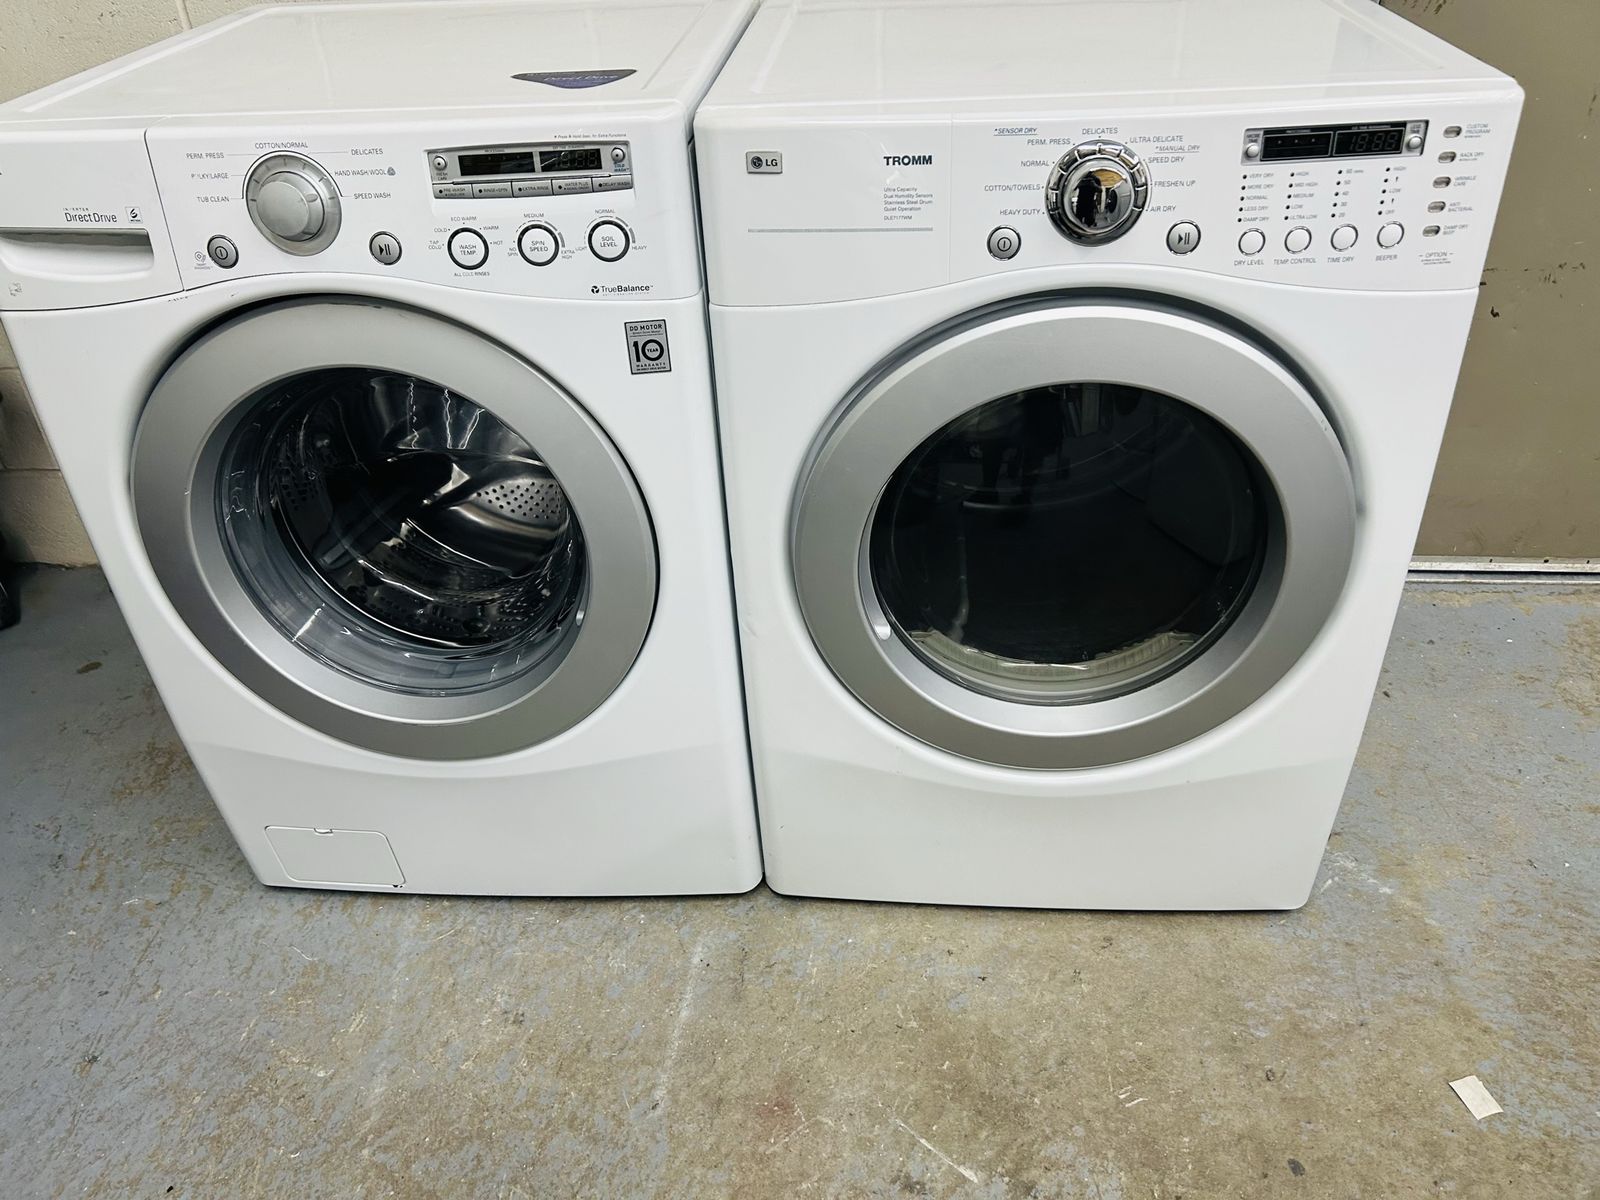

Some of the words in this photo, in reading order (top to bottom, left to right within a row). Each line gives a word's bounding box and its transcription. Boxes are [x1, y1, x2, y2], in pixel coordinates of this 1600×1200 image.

[1081, 127, 1118, 135] DELICATES
[1129, 136, 1151, 144] ULTRA
[1152, 135, 1183, 143] DELICATE
[255, 141, 308, 149] COTTON/NORMAL
[765, 158, 778, 167] LG
[883, 155, 933, 166] TROMM
[210, 195, 230, 203] CLEAN
[1375, 254, 1398, 262] BEEPER
[632, 338, 665, 363] 10
